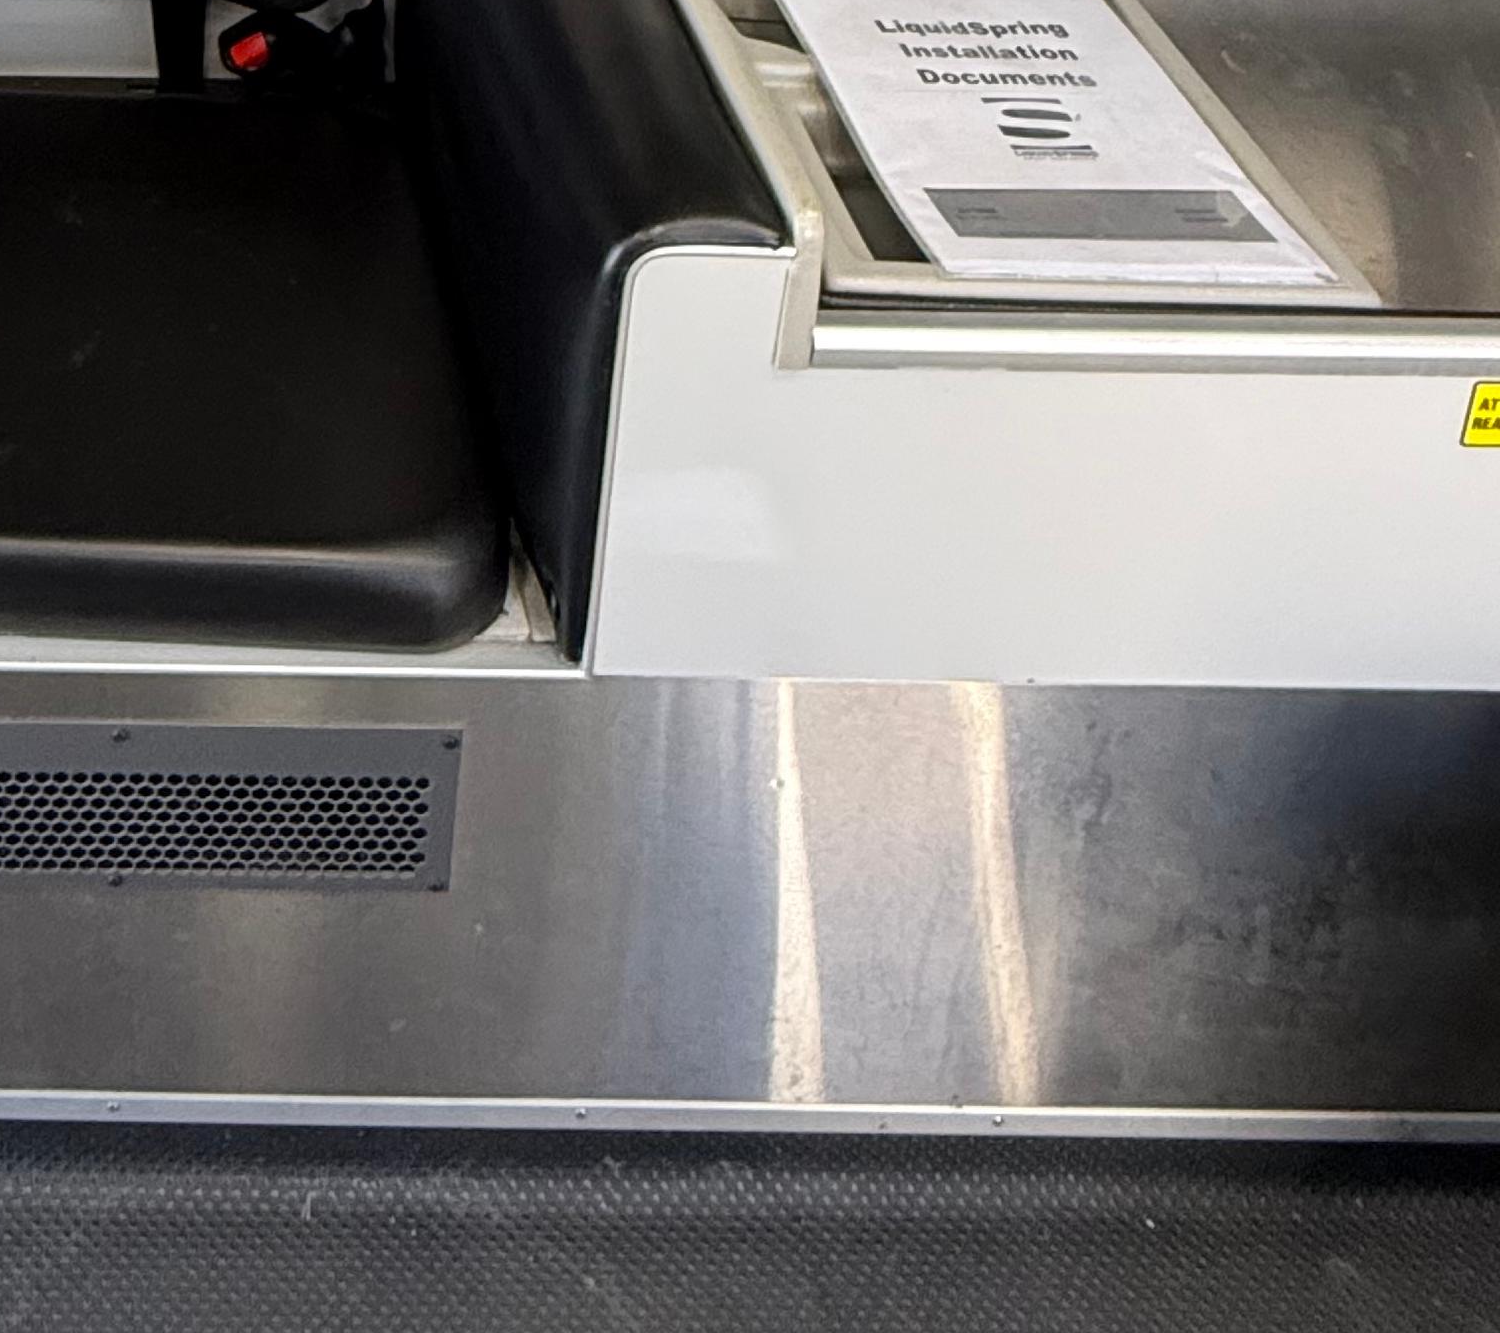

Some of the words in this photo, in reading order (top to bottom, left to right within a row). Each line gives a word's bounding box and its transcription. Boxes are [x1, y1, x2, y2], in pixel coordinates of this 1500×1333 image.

[874, 20, 1069, 39] LiquidSpring
[898, 43, 1079, 61] Installation
[916, 69, 1098, 87] Documents
